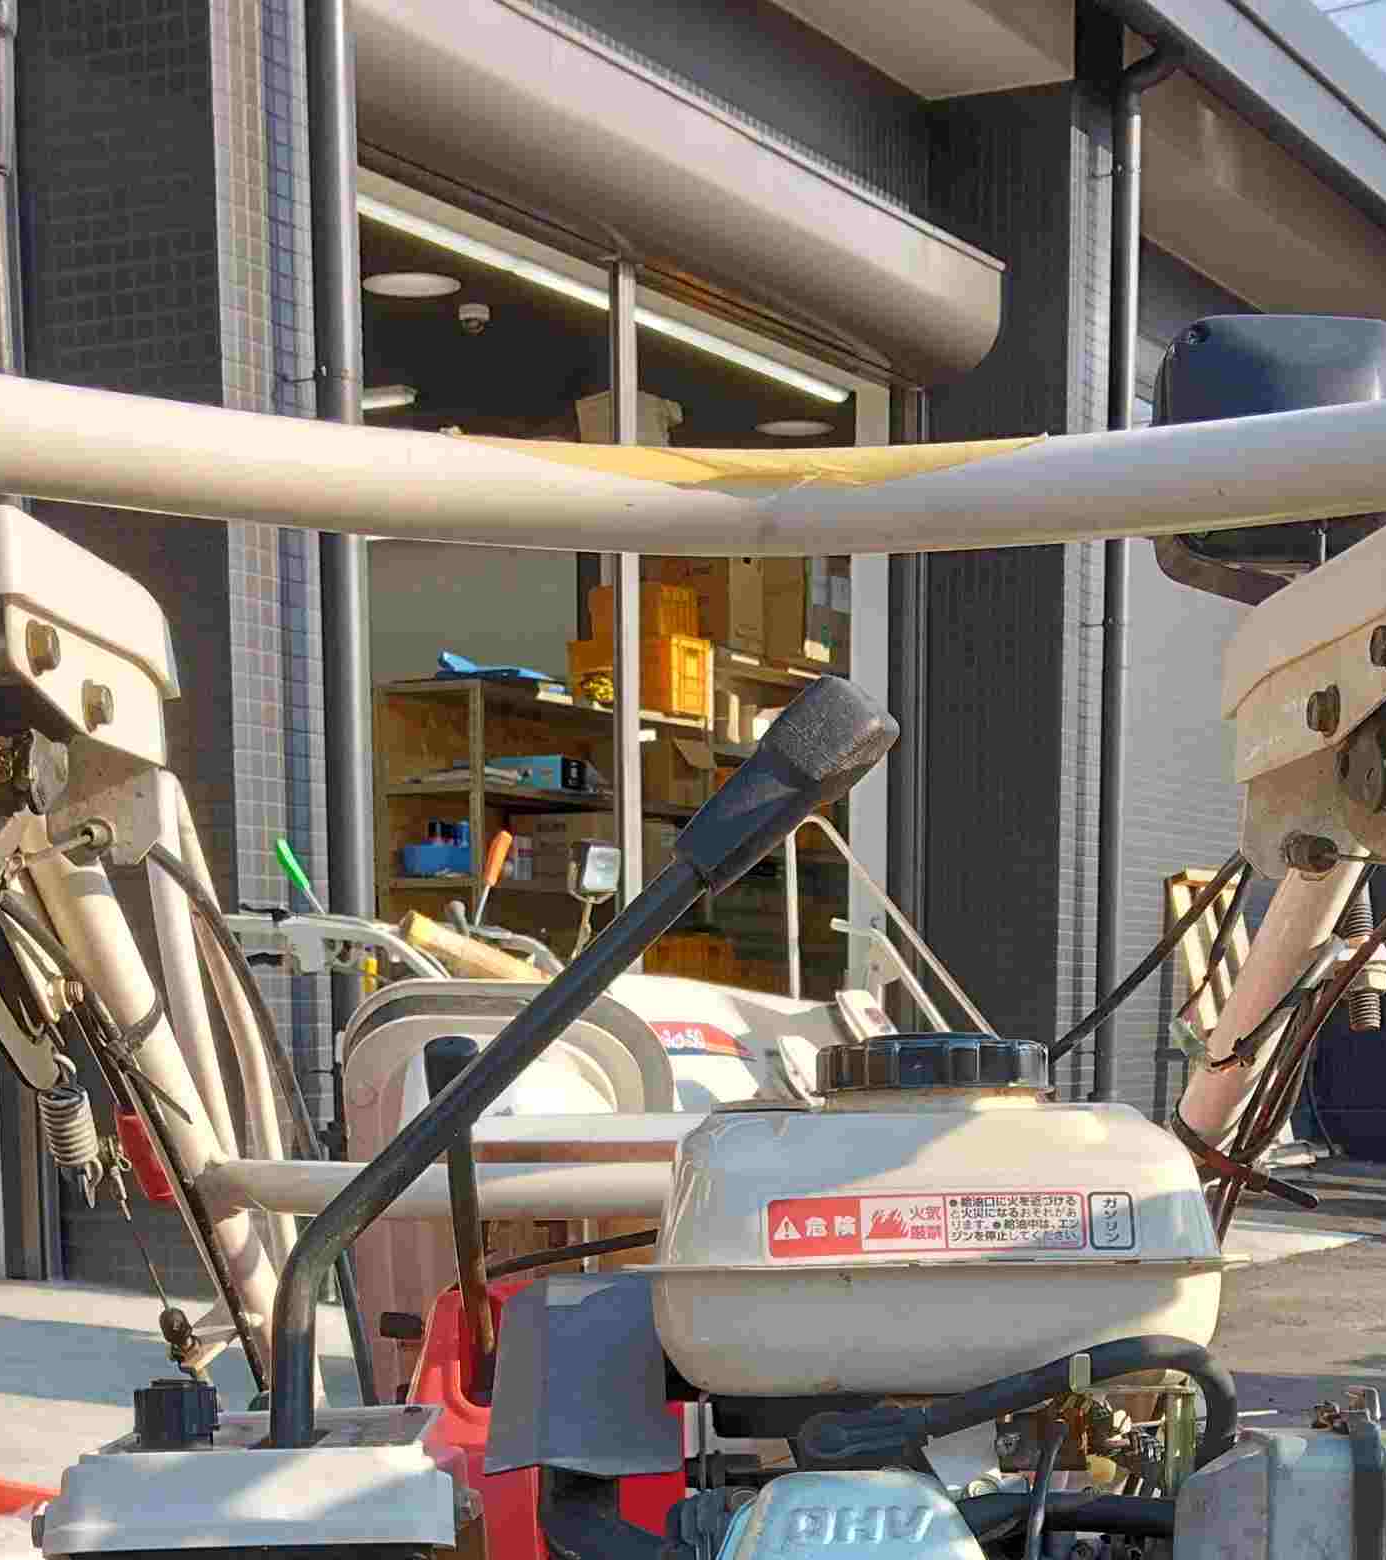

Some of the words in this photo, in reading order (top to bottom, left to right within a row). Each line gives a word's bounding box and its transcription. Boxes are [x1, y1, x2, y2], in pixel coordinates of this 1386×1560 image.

[1102, 1197, 1120, 1243] ガソリン
[789, 1505, 935, 1546] OHV
